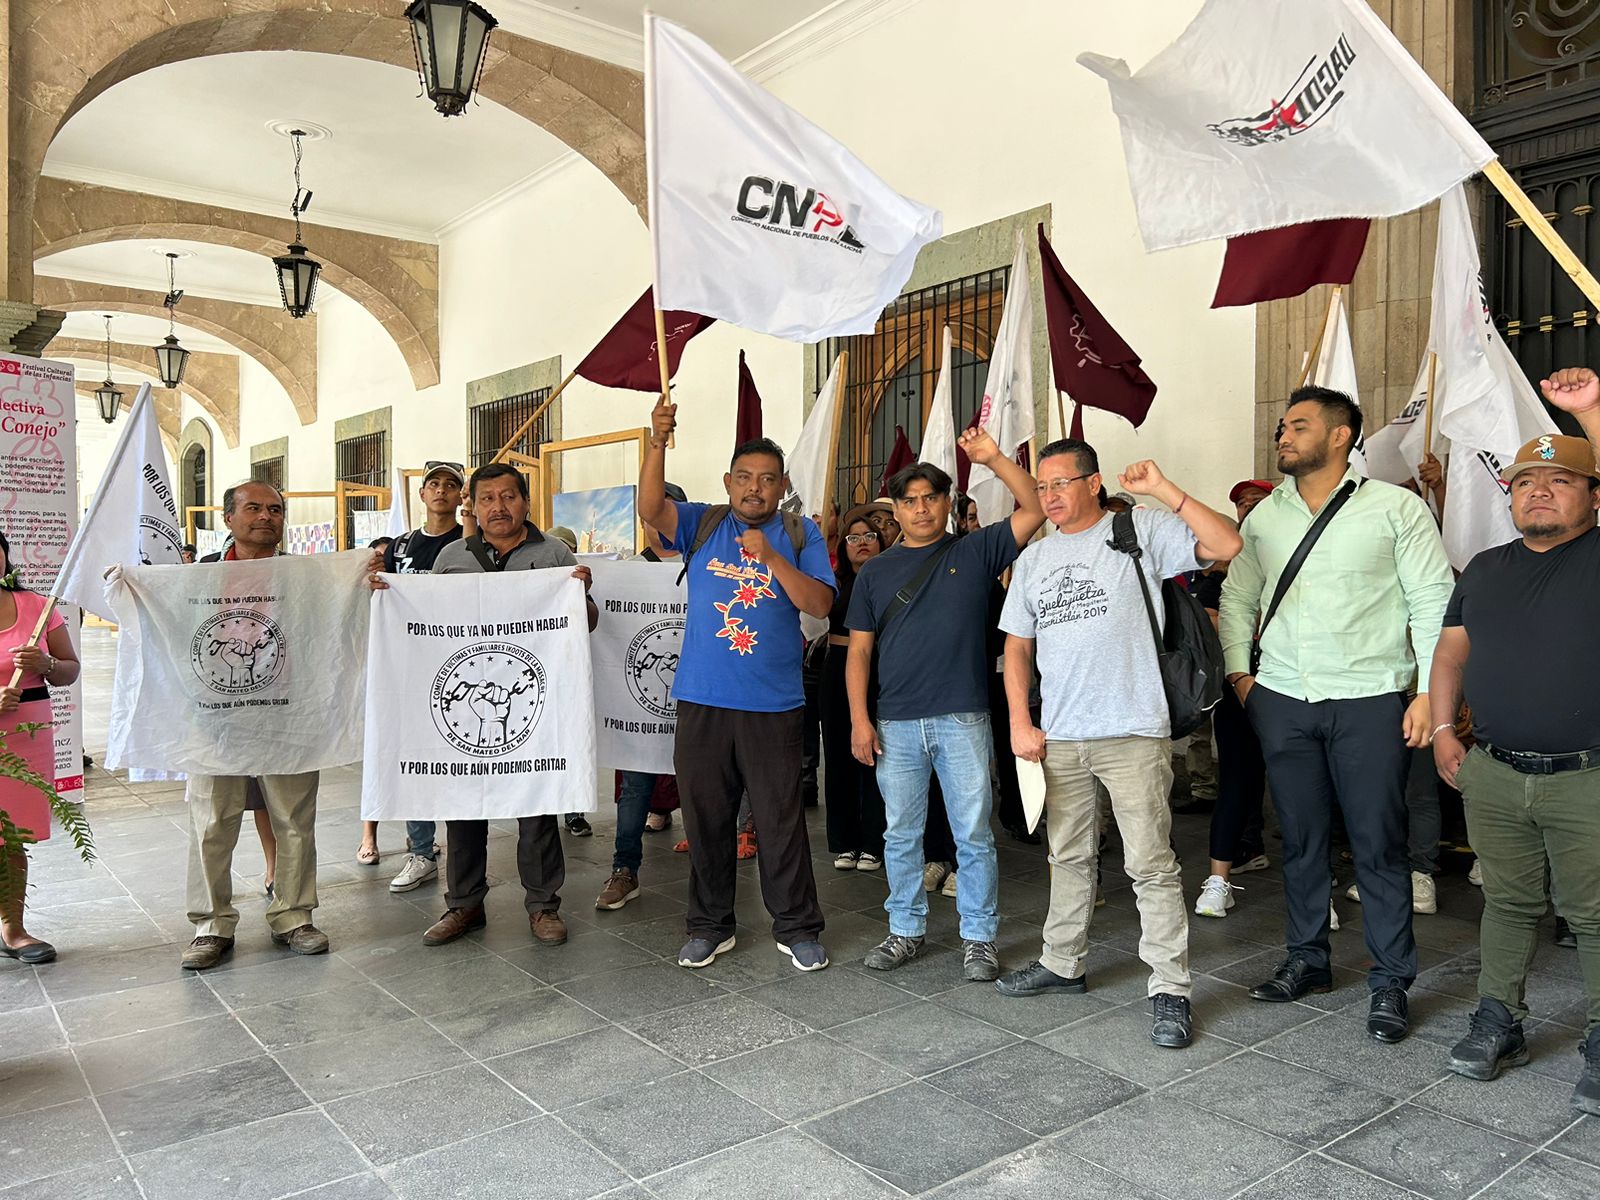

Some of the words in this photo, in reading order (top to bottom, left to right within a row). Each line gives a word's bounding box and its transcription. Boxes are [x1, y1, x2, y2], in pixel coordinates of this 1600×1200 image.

[761, 224, 792, 236] NACIONAL
[792, 230, 801, 238] DE
[801, 230, 829, 241] PUEBLOS
[830, 237, 840, 245] EN
[22, 363, 46, 372] Festival
[47, 367, 72, 377] Cultural
[43, 373, 71, 382] Infancias
[142, 463, 160, 485] POR
[152, 481, 170, 500] LOS
[163, 498, 177, 517] QUE
[605, 600, 622, 613] POR
[623, 601, 638, 613] LOS
[641, 602, 656, 614] QUE
[658, 603, 668, 614] YA
[670, 603, 681, 614] NO
[1038, 585, 1106, 618] Guelaguetza
[1083, 605, 1108, 619] 2019
[407, 622, 427, 636] POR
[428, 624, 445, 637] LOS
[446, 625, 465, 638] QUE
[467, 625, 479, 637] YA
[481, 624, 494, 636] NO
[496, 620, 534, 636] PUEDEN
[536, 616, 569, 632] HABLAR
[632, 640, 639, 648] DE
[440, 667, 450, 677] DE
[471, 644, 505, 653] FAMILIARES
[524, 653, 532, 662] DE
[530, 660, 538, 669] LA
[639, 696, 647, 706] DE
[646, 703, 660, 714] SAN
[604, 717, 609, 728] Y
[610, 718, 624, 731] POR
[625, 721, 639, 733] LOS
[641, 722, 657, 734] QUE
[658, 721, 675, 734] AÚN
[446, 732, 457, 743] DE
[456, 741, 471, 752] SAN
[501, 742, 516, 752] DEL
[516, 728, 531, 744] MAR
[400, 761, 406, 774] Y
[408, 761, 428, 774] POR
[430, 762, 448, 775] LOS
[450, 762, 468, 776] QUE
[470, 760, 489, 776] AÚN
[491, 760, 532, 774] PODEMOS
[534, 758, 567, 772] GRITAR
